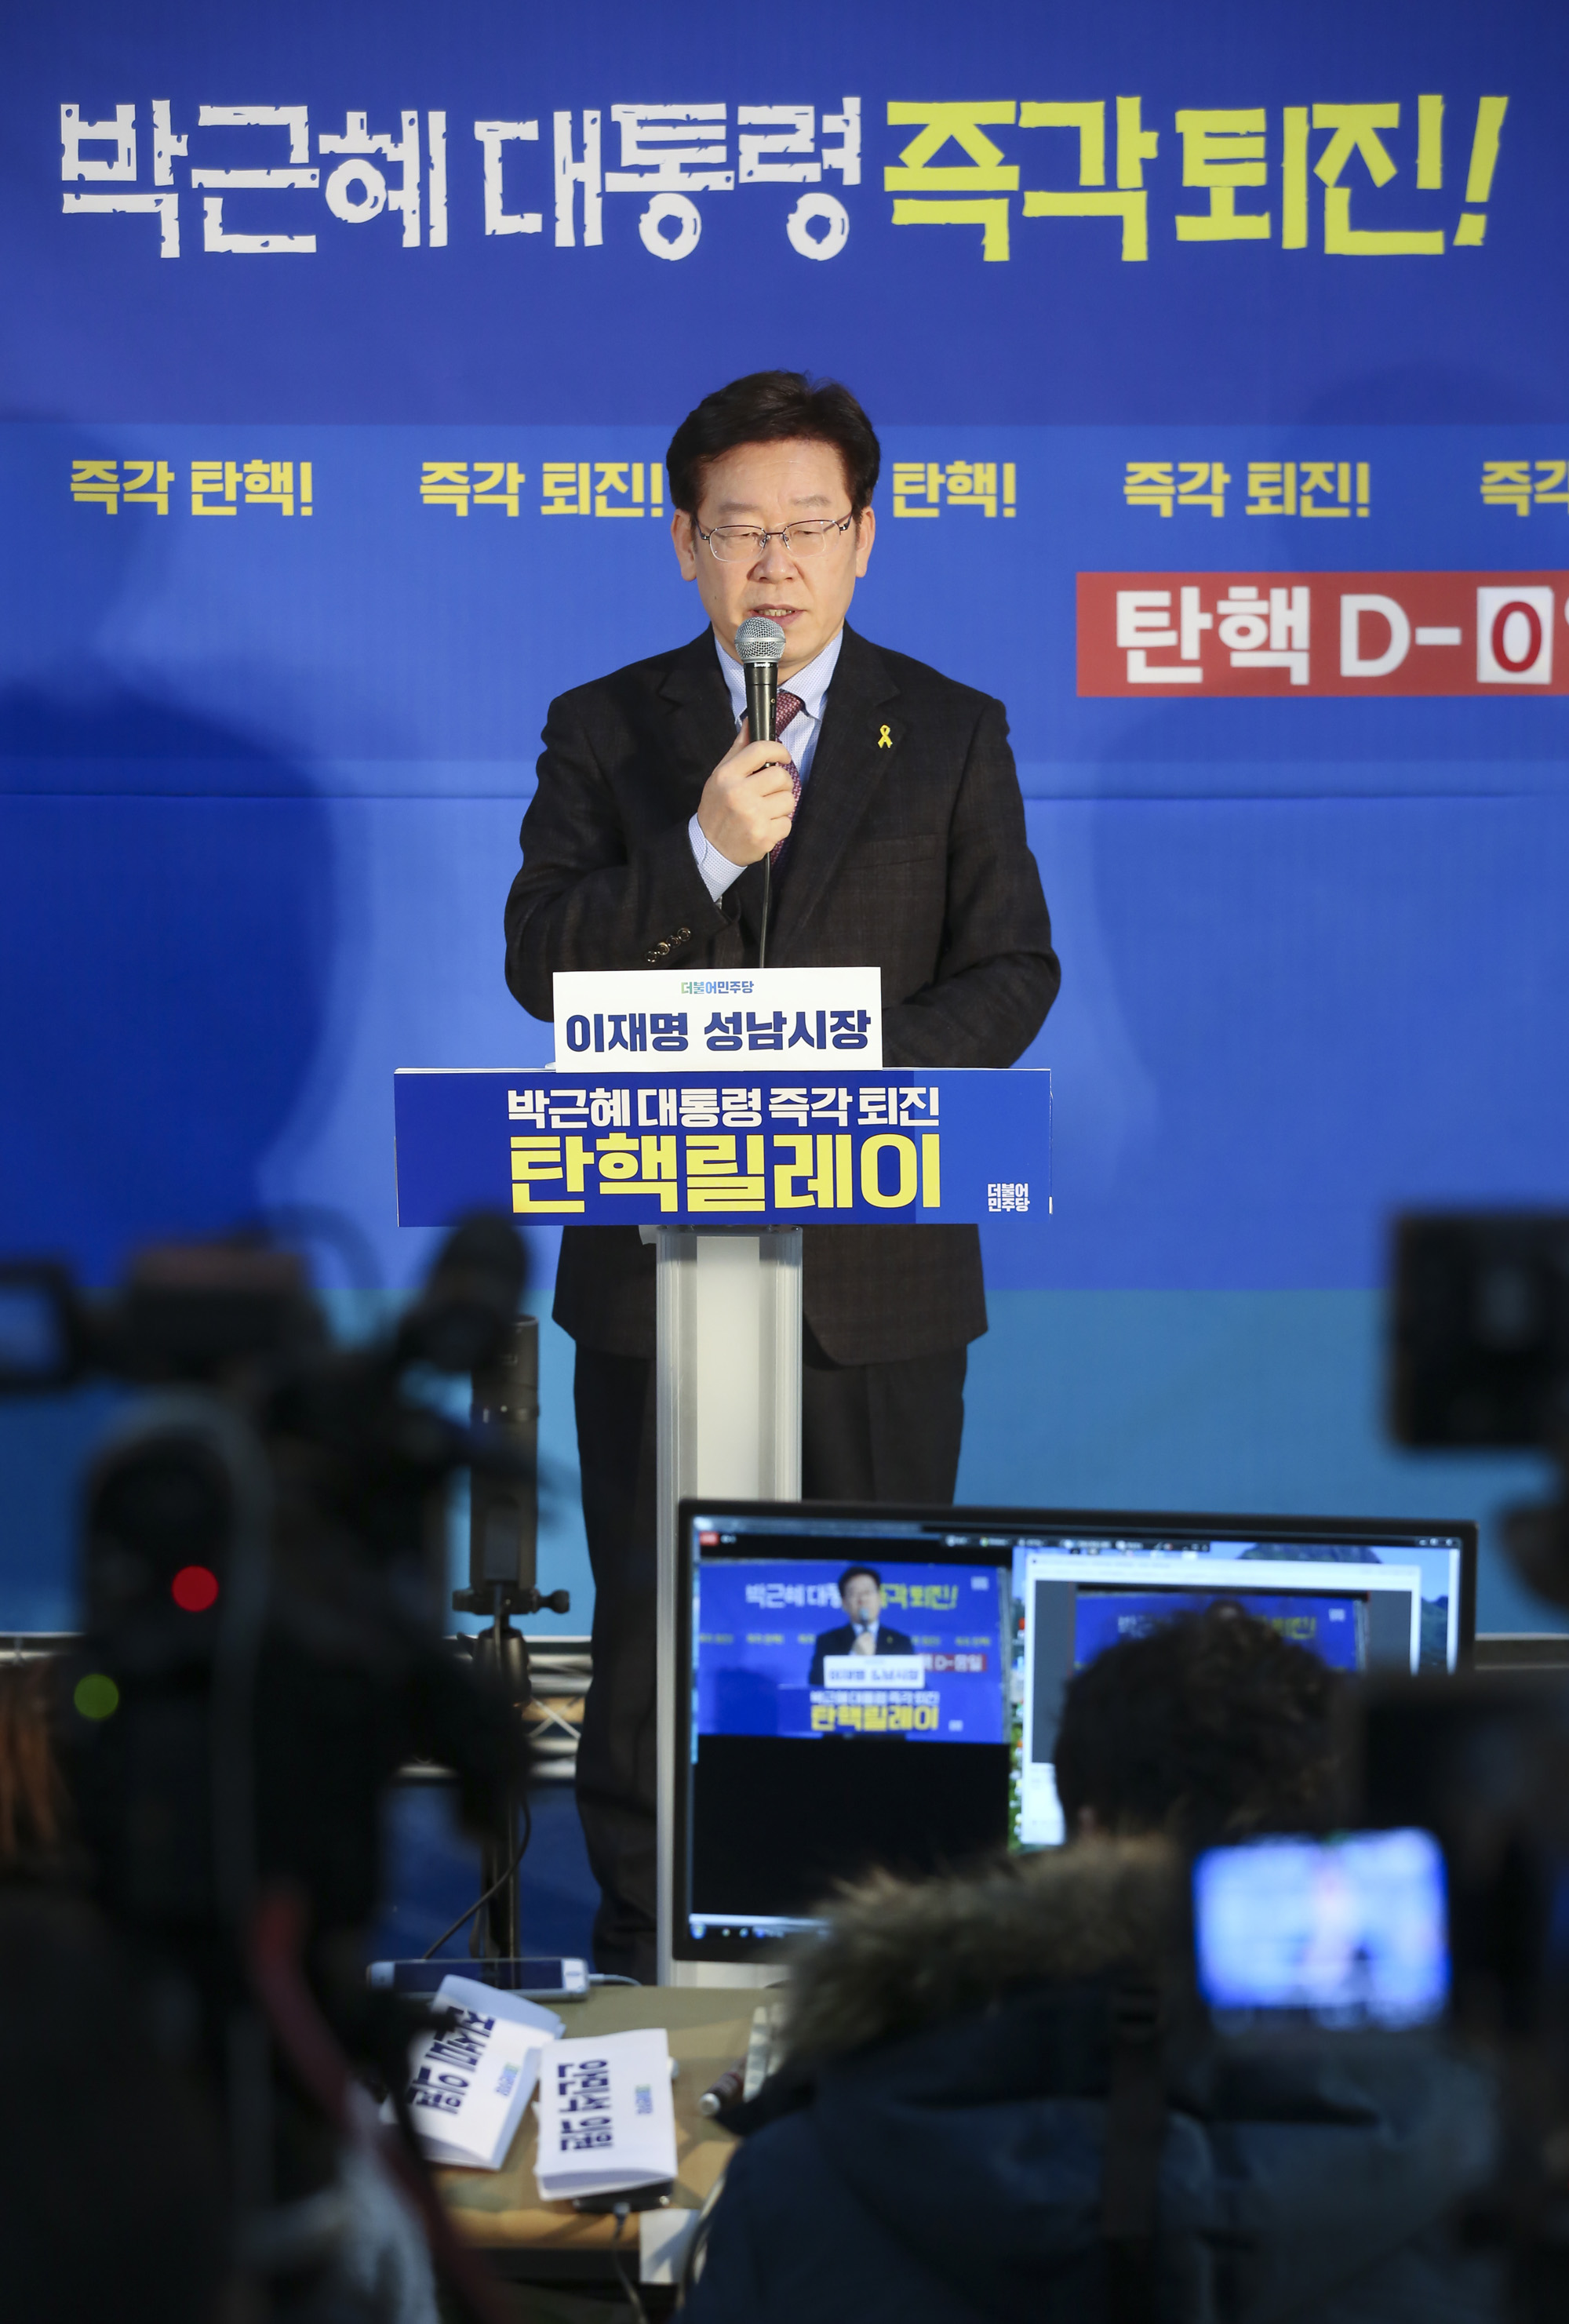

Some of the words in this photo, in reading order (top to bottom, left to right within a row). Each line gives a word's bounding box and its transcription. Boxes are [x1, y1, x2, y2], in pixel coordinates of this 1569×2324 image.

[61, 100, 448, 259] 박근혜
[474, 97, 861, 261] 대통령
[883, 96, 1159, 262] 즉각
[1174, 95, 1509, 256] 퇴진!
[70, 460, 175, 515] 즉각
[191, 459, 314, 517] 탄핵!
[419, 461, 526, 518] 즉각
[540, 462, 664, 518] 퇴진!
[892, 460, 1017, 518] 탄핵!
[1123, 462, 1231, 518] 즉각
[1245, 462, 1370, 518] 퇴진!
[1116, 586, 1311, 686] 탄핵
[1340, 592, 1569, 678] D-0
[681, 980, 755, 995] 더불어민주당
[566, 1012, 689, 1053] 이재명
[704, 1009, 872, 1052] 성남시장
[507, 1087, 629, 1129] 박근혜
[637, 1088, 763, 1128] 대통령
[768, 1087, 854, 1127] 즉각
[857, 1086, 940, 1126] 퇴진
[510, 1132, 941, 1213] 탄핵릴레이
[987, 1183, 1028, 1198] 더불어
[988, 1197, 1031, 1213] 민주당
[559, 2115, 613, 2152] 의원
